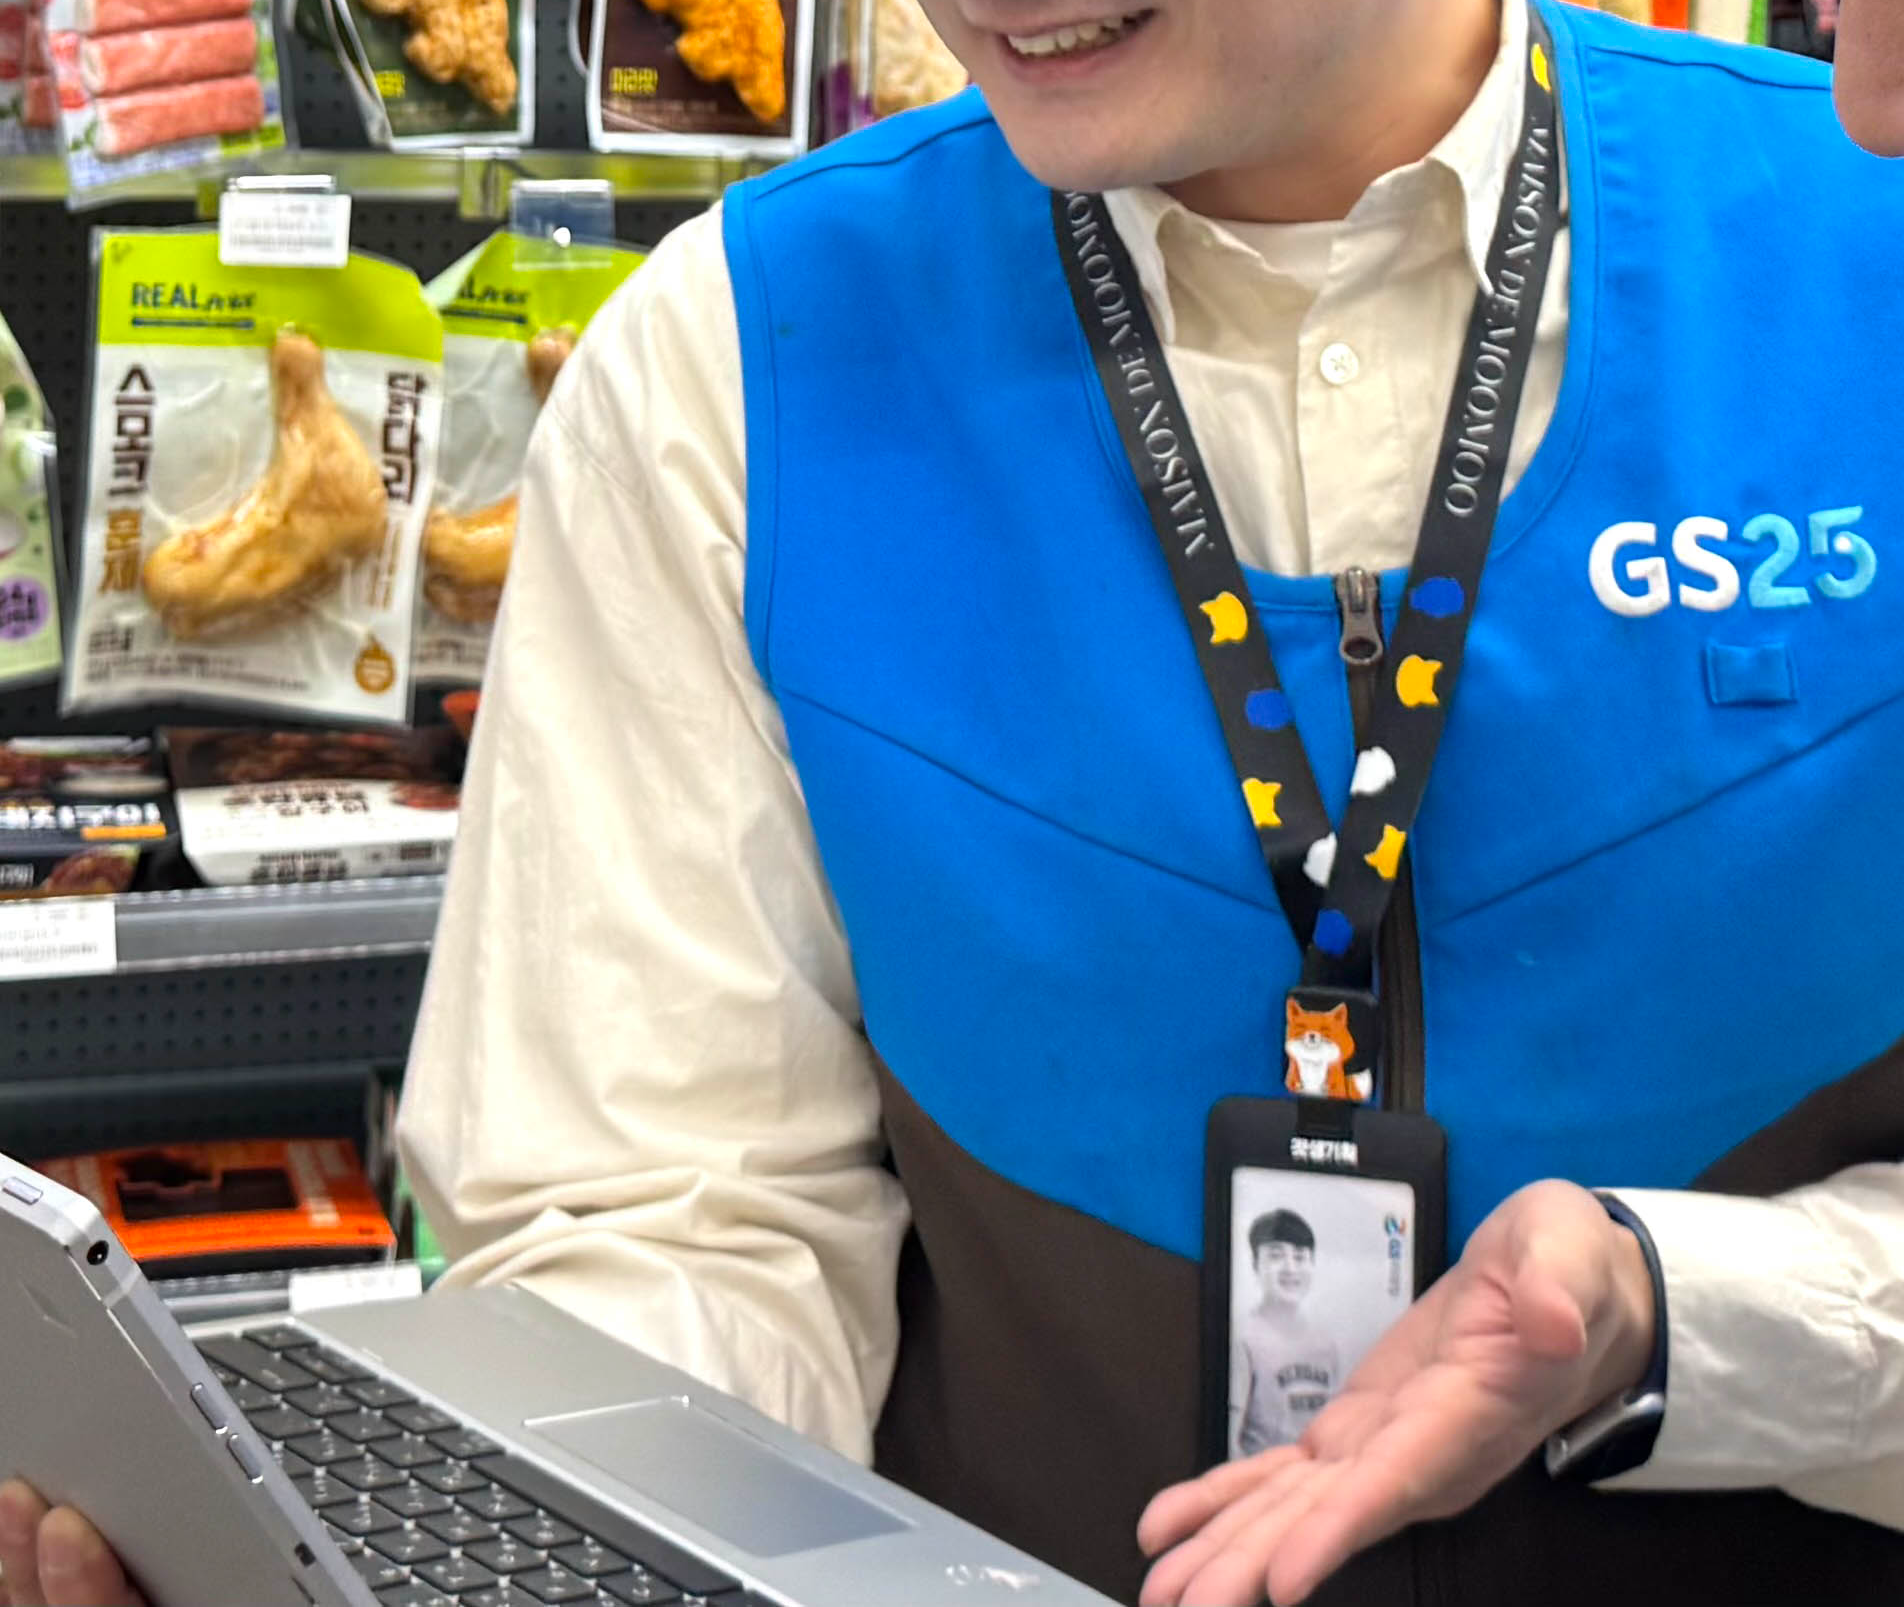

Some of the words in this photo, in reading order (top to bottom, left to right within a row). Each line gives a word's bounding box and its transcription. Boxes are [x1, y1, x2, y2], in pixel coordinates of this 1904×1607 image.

[1064, 191, 1140, 346] MOOMO
[108, 363, 156, 498] 스모크
[380, 370, 427, 507] 닭다리
[1117, 347, 1155, 396] DE
[1133, 398, 1215, 558] MAISON
[1588, 505, 1878, 618] GS25
